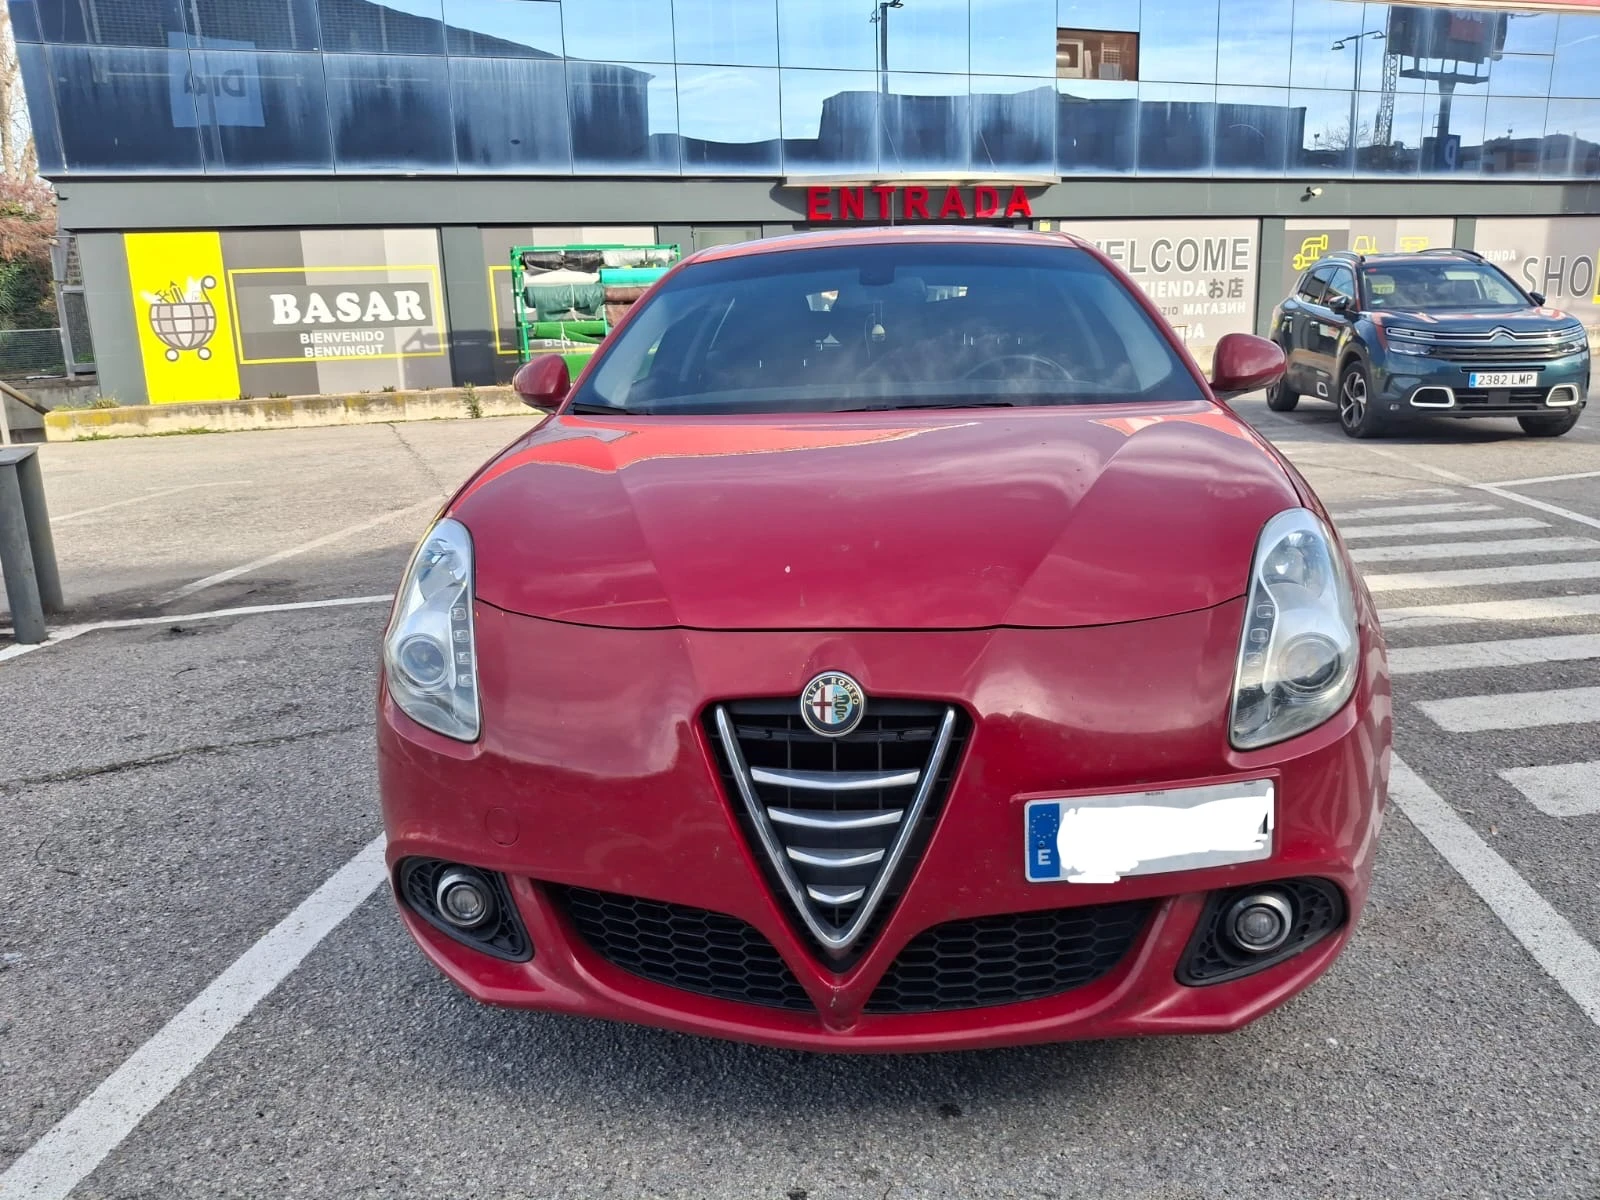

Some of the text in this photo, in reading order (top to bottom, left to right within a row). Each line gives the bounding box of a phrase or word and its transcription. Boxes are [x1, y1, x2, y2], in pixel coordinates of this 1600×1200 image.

[806, 185, 1033, 221] ENTRADA
[1095, 237, 1250, 274] ELCOME
[1141, 280, 1208, 298] TIENDA
[1208, 277, 1244, 299] お店
[269, 290, 426, 325] BASAR
[1183, 301, 1246, 316] МАГАЗИН
[300, 330, 385, 344] BIENVENIDO
[304, 344, 384, 358] BENVINGUT
[1478, 374, 1508, 386] 2382
[1511, 373, 1533, 385] LMP
[806, 677, 860, 706] ALFA ROMEO
[1037, 848, 1052, 866] E
